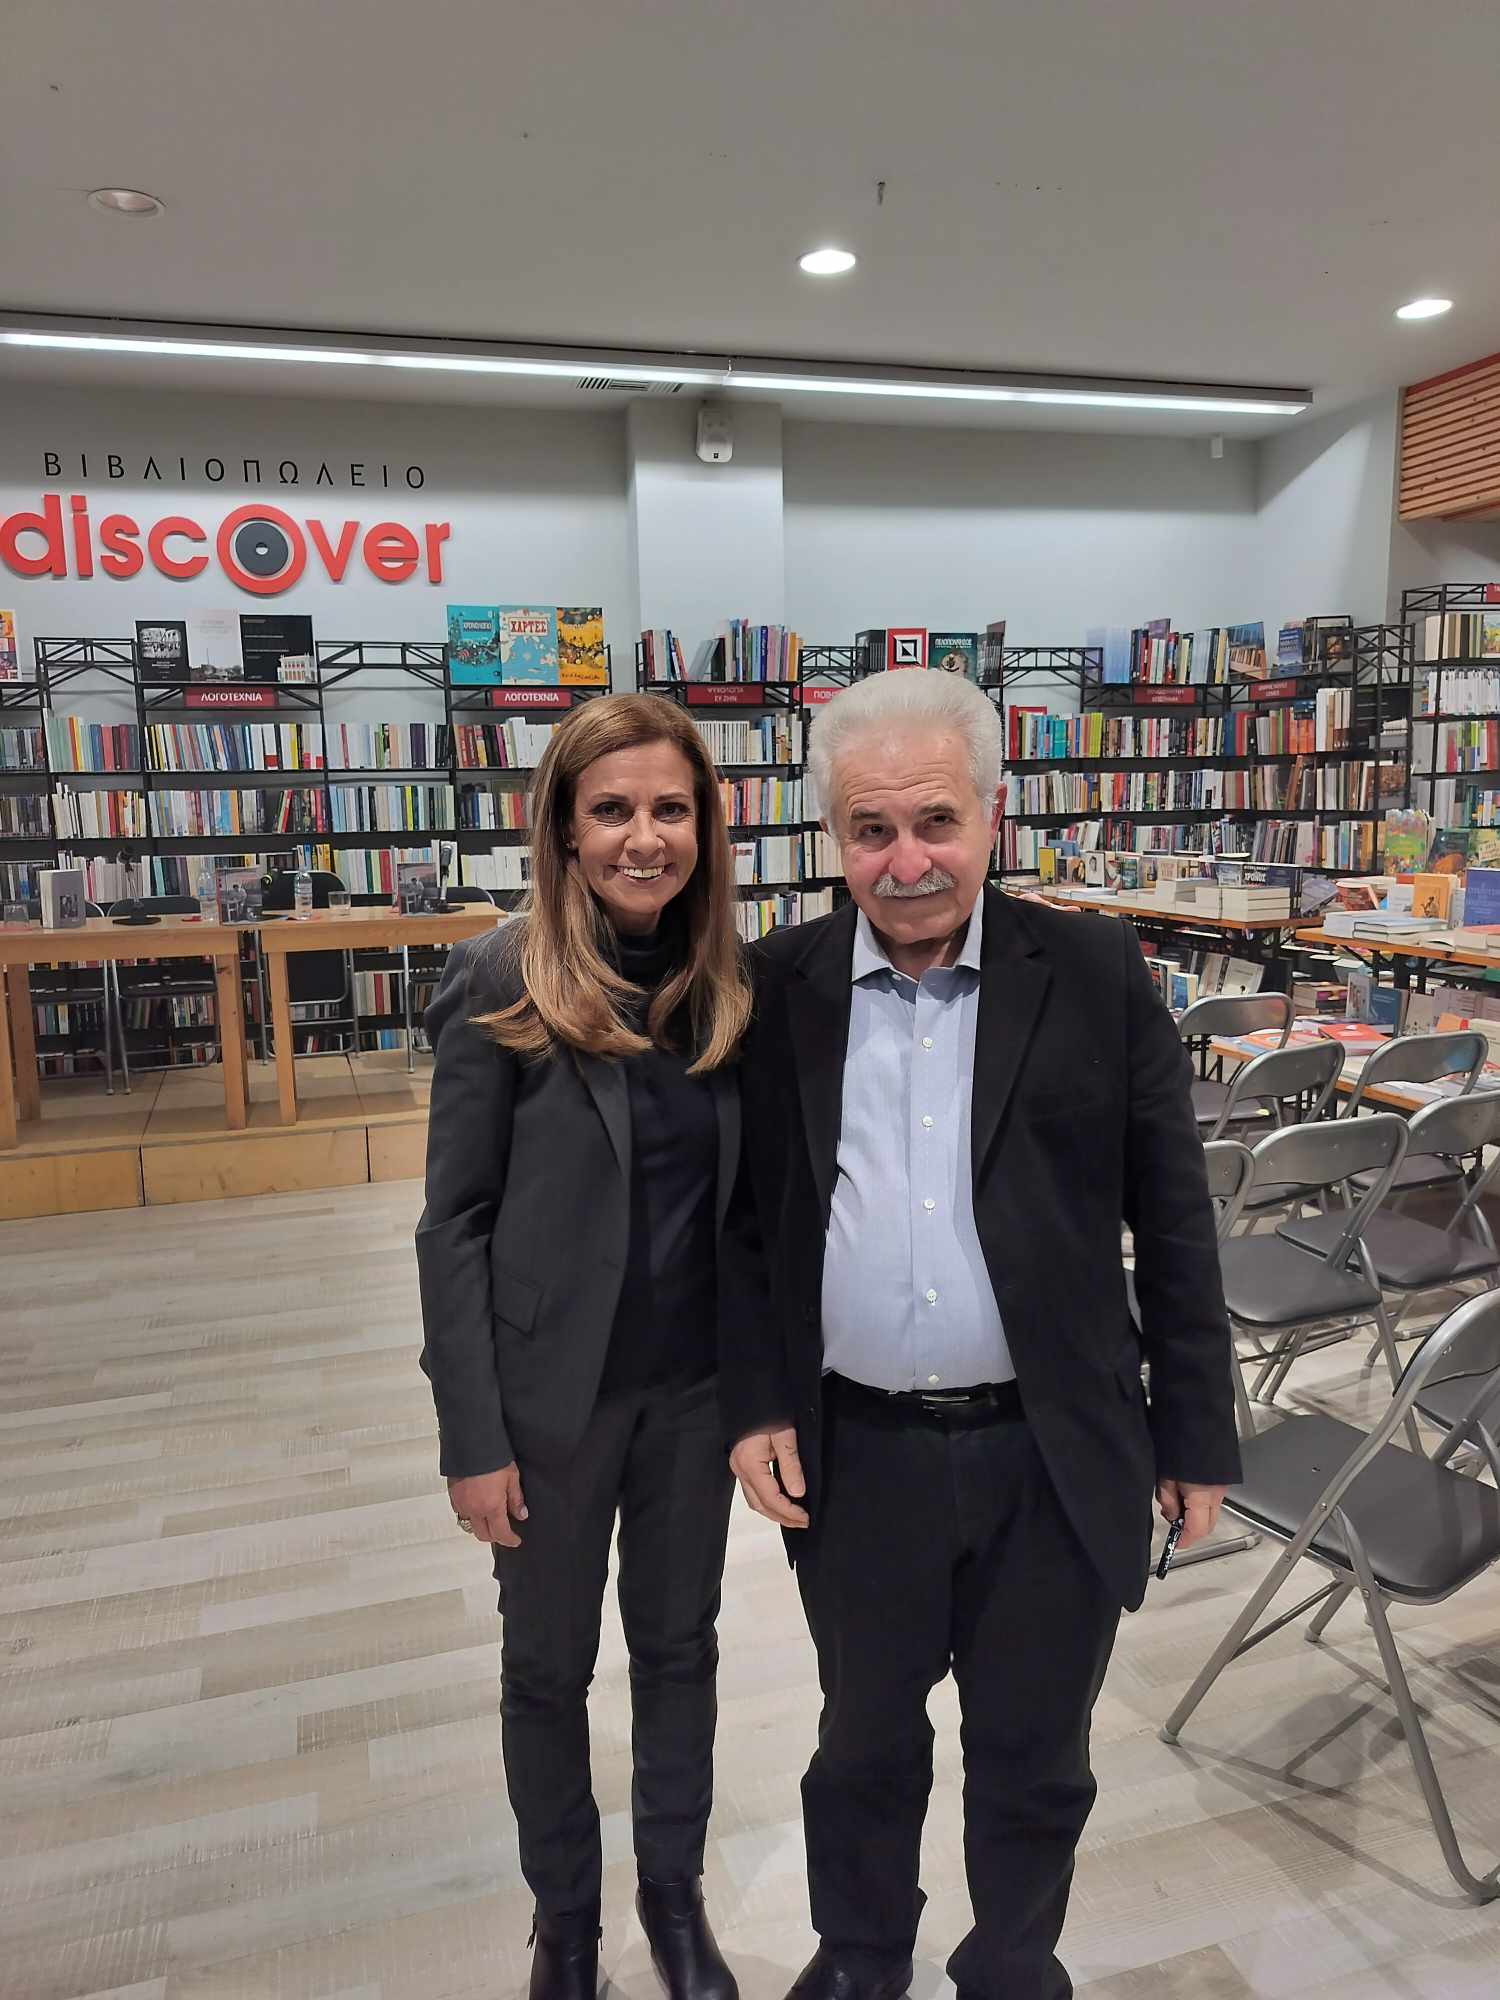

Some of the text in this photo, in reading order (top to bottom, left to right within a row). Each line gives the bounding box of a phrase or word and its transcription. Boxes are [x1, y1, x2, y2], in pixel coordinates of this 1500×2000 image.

[43, 451, 426, 490] ΒΙΒΛΙΟΠΩΛΕΙΟ
[510, 619, 547, 634] ΧΑΡΤΕΣ
[200, 692, 263, 702] ΛΟΓΟΤΕΧΝΙΑ
[504, 692, 560, 702] ΛΟΓΟΤΕΧΝΙΑ
